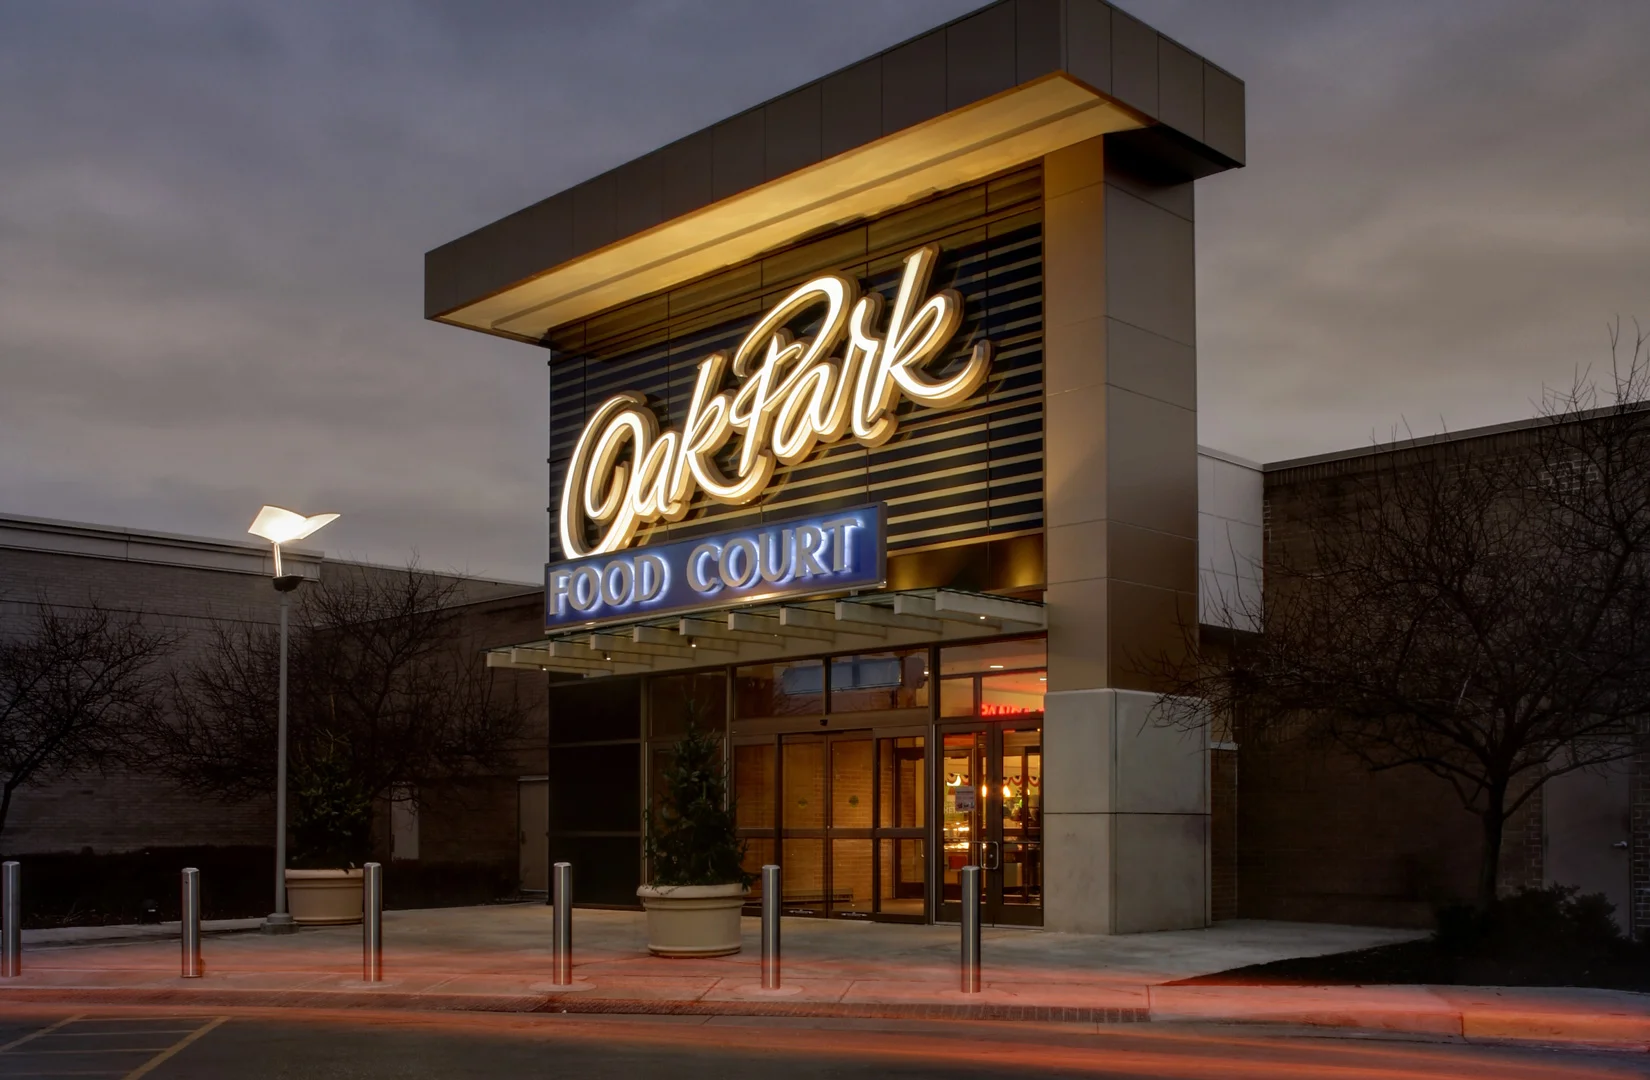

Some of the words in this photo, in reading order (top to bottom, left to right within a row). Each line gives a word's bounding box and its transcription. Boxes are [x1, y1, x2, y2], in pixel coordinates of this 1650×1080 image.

[560, 353, 773, 560] Oak
[729, 243, 991, 479] Park
[549, 554, 671, 616] FOOD
[686, 517, 863, 595] COURT
